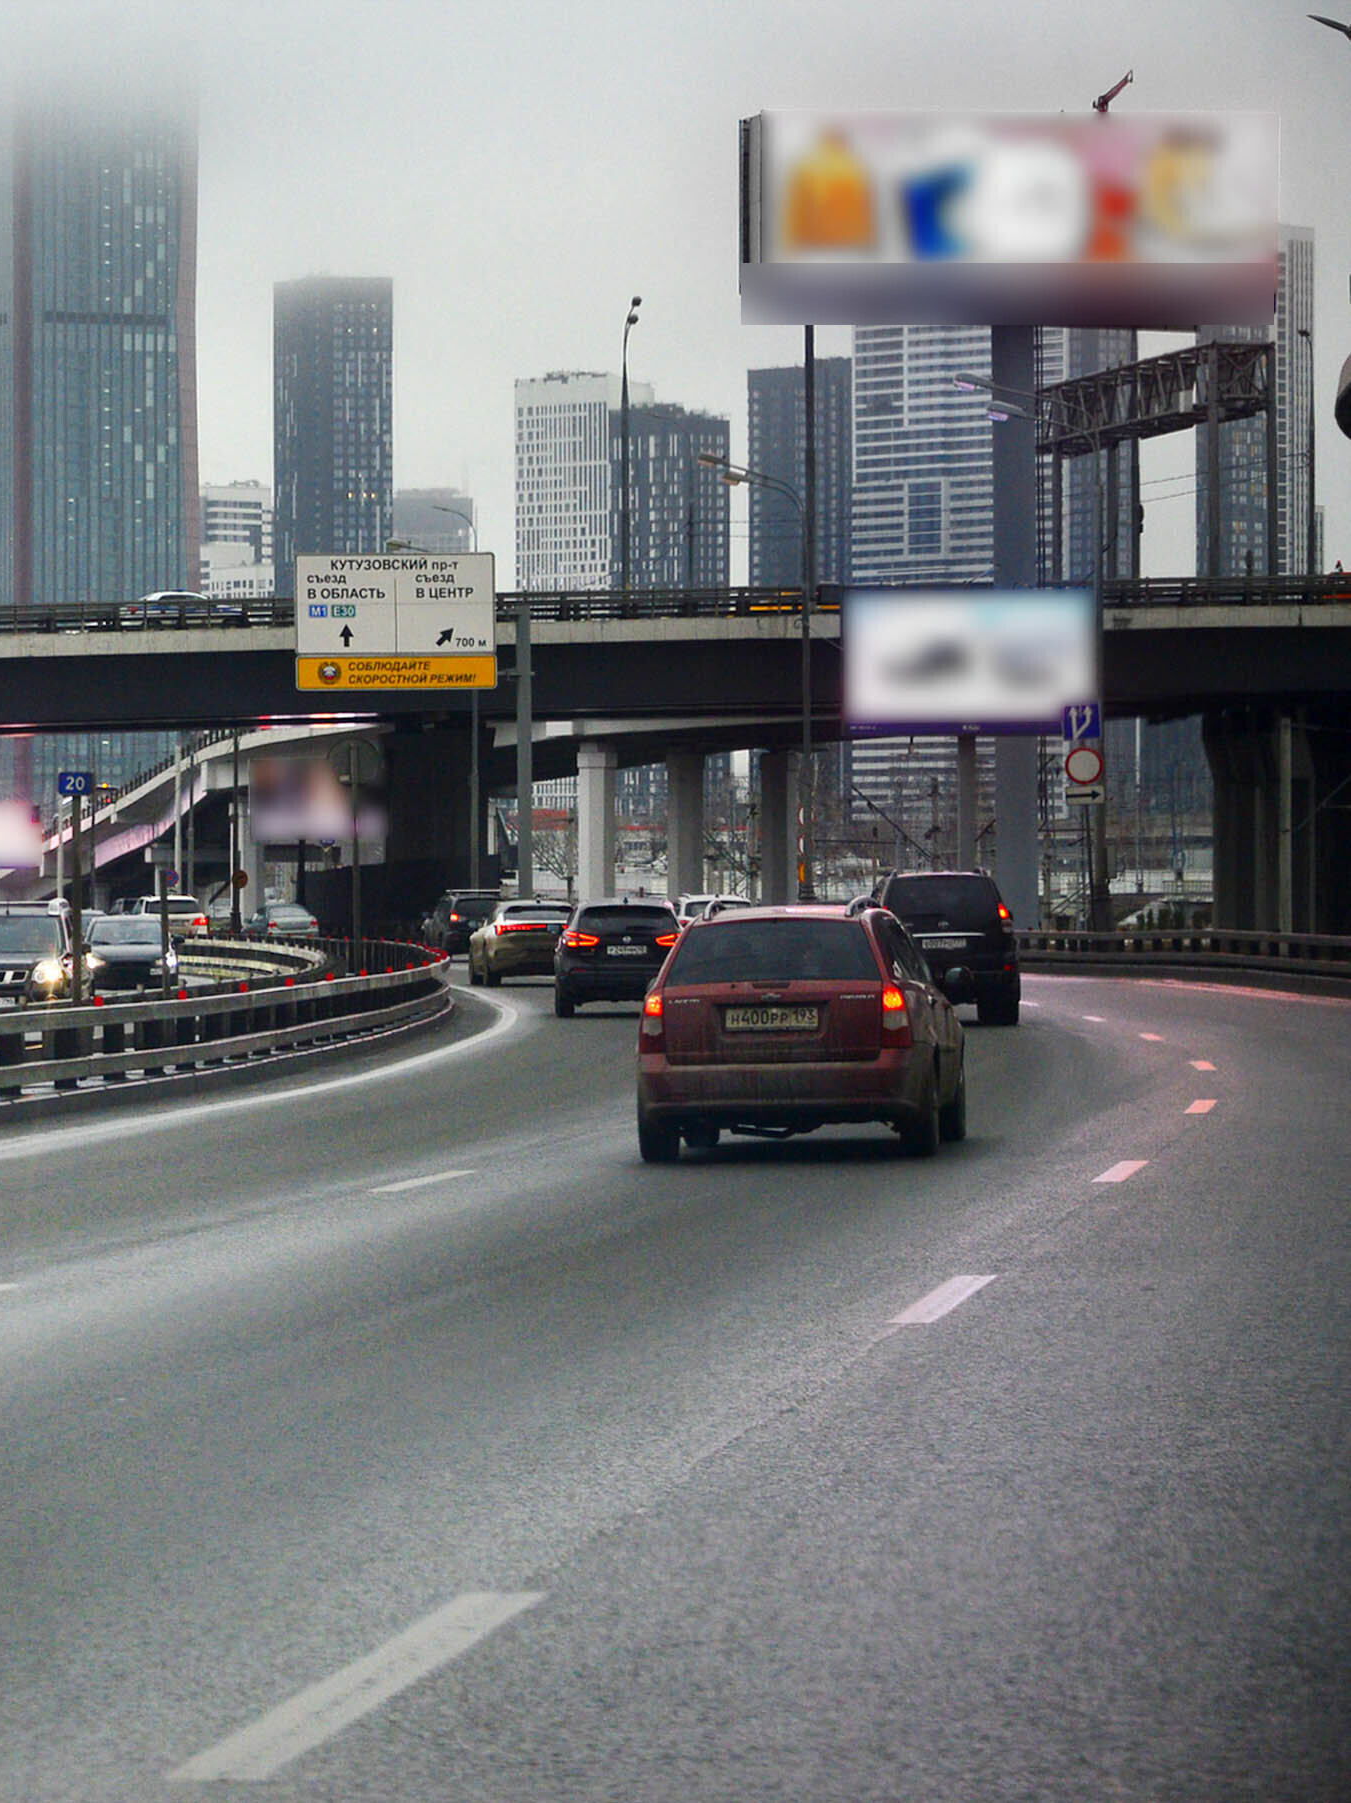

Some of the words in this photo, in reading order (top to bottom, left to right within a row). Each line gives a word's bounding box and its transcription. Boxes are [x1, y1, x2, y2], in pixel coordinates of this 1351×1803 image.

[330, 557, 428, 571] КУТУЗОВСКИЙ
[431, 560, 459, 573] пр-т
[307, 574, 347, 585] съезд
[415, 573, 455, 584] съезд
[307, 587, 317, 599] В
[320, 587, 386, 599] ОБЛАСТЬ
[416, 587, 425, 599] В
[429, 587, 474, 600] ЦЕНТР
[455, 637, 475, 648] 700
[348, 660, 431, 672] СОБЛЮДАЙТЕ
[348, 672, 427, 684] СКОРОСТНОЙ
[429, 673, 477, 684] РЕЖИМ!
[65, 776, 86, 791] 20
